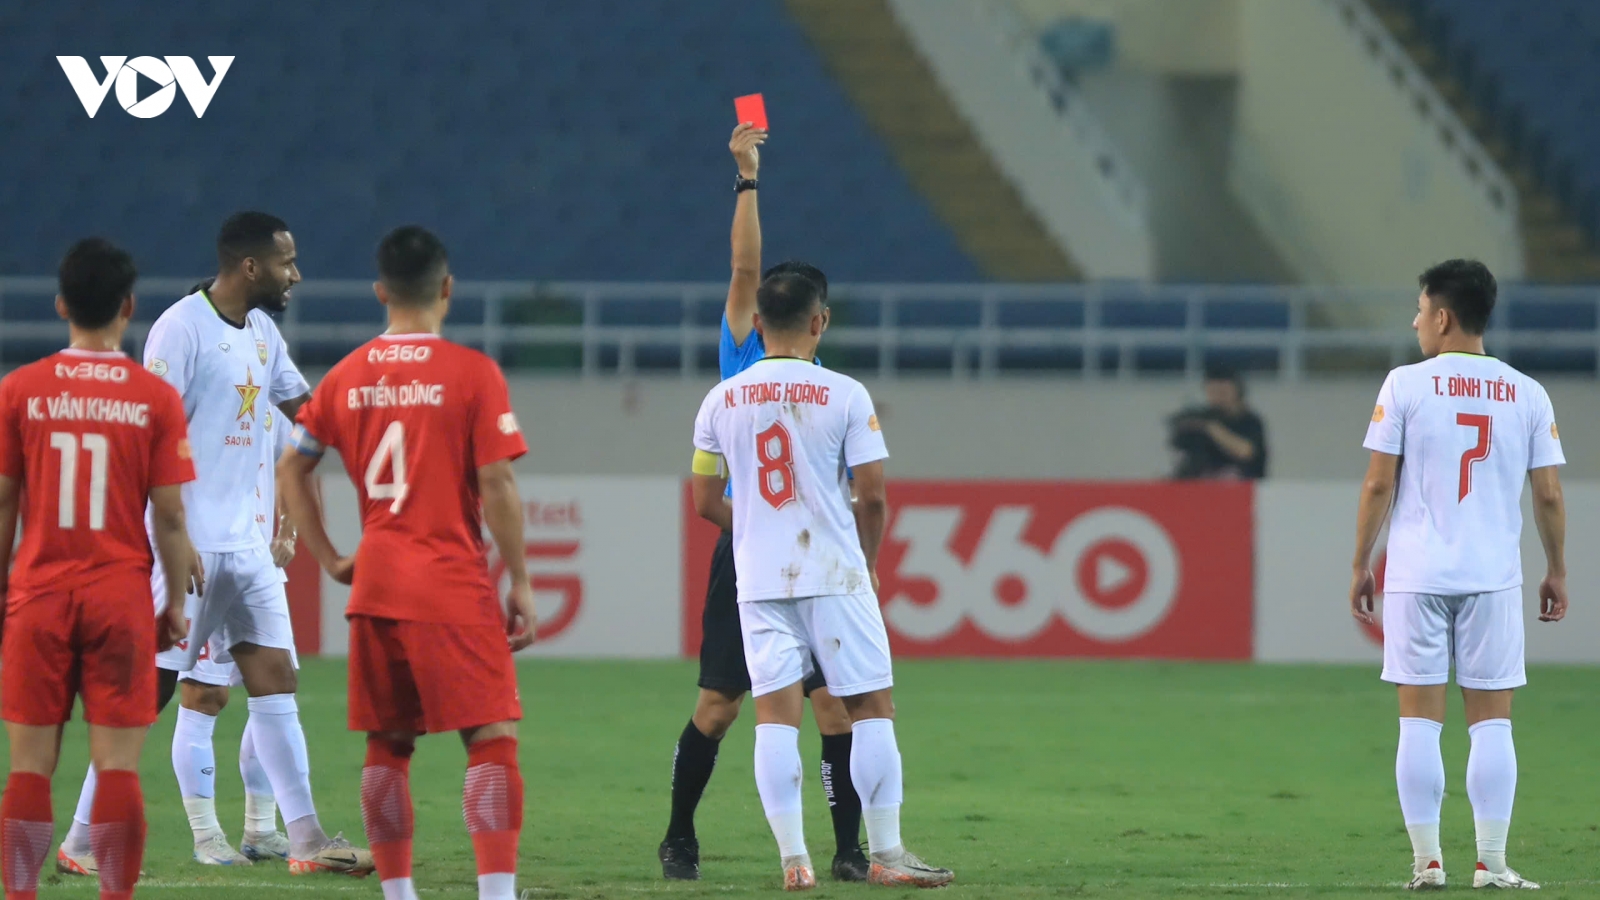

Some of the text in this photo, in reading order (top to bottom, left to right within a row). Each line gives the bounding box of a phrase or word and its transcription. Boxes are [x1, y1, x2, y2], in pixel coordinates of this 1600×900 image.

[54, 362, 128, 382] tv360
[367, 344, 431, 363] tv360
[27, 391, 149, 428] K. VĂN KHANG
[724, 380, 830, 409] N. TRỌNG HOÀNG
[1431, 373, 1516, 403] T. ĐÌNH TIẾN
[364, 420, 409, 515] 4
[755, 419, 797, 511] 8
[1456, 412, 1493, 506] 7
[50, 431, 109, 531] 11
[821, 759, 837, 808] JOGARBOLA
